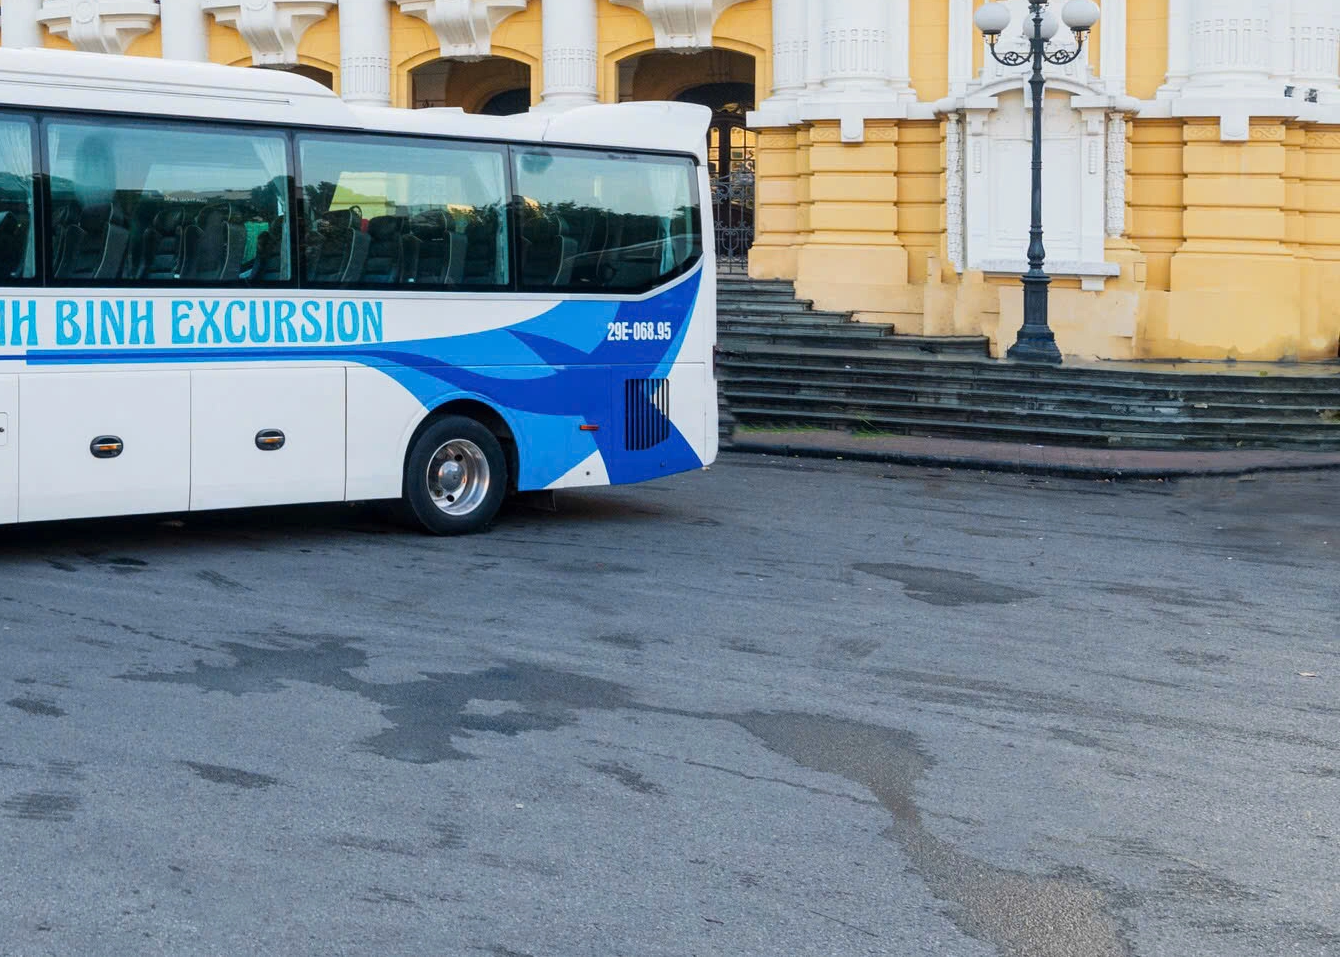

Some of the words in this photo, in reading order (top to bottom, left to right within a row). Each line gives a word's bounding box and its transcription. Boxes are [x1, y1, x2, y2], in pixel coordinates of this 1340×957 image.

[55, 300, 156, 345] BINH
[171, 300, 383, 344] EXCURSION
[606, 321, 672, 341] 29E-068.95
